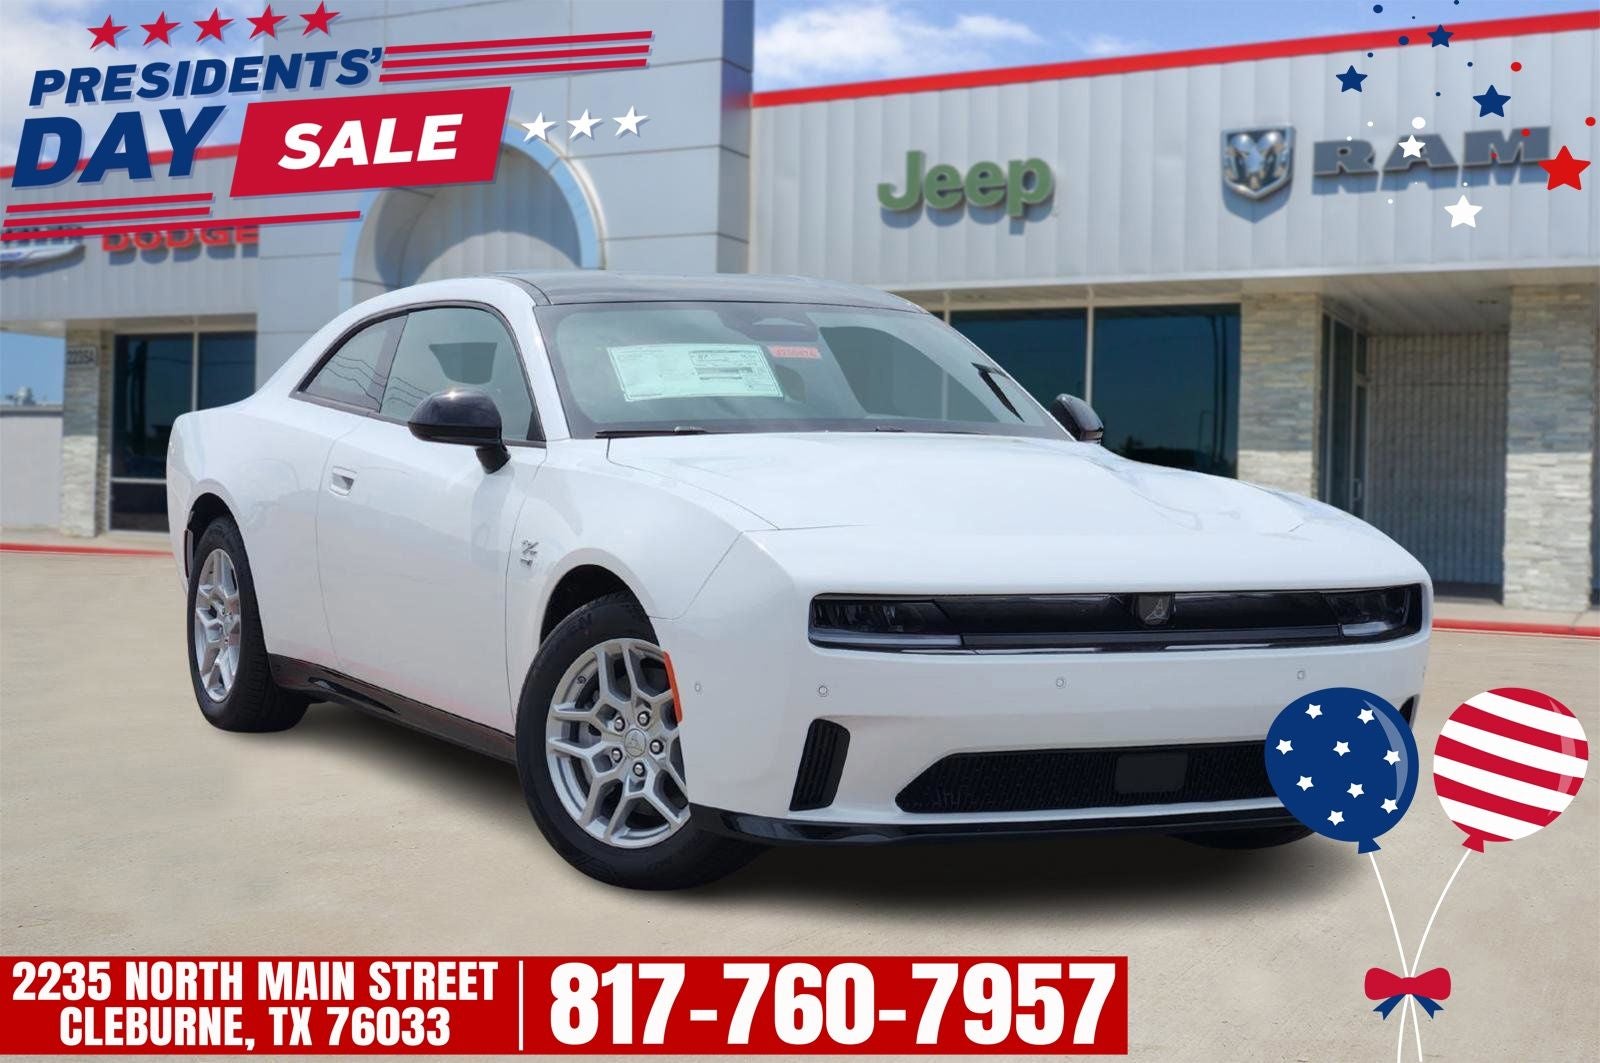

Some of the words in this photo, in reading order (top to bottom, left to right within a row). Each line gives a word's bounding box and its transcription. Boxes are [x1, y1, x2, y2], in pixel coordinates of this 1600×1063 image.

[1313, 126, 1551, 175] RAM
[877, 150, 1054, 217] Jeep
[102, 224, 259, 253] DODGE
